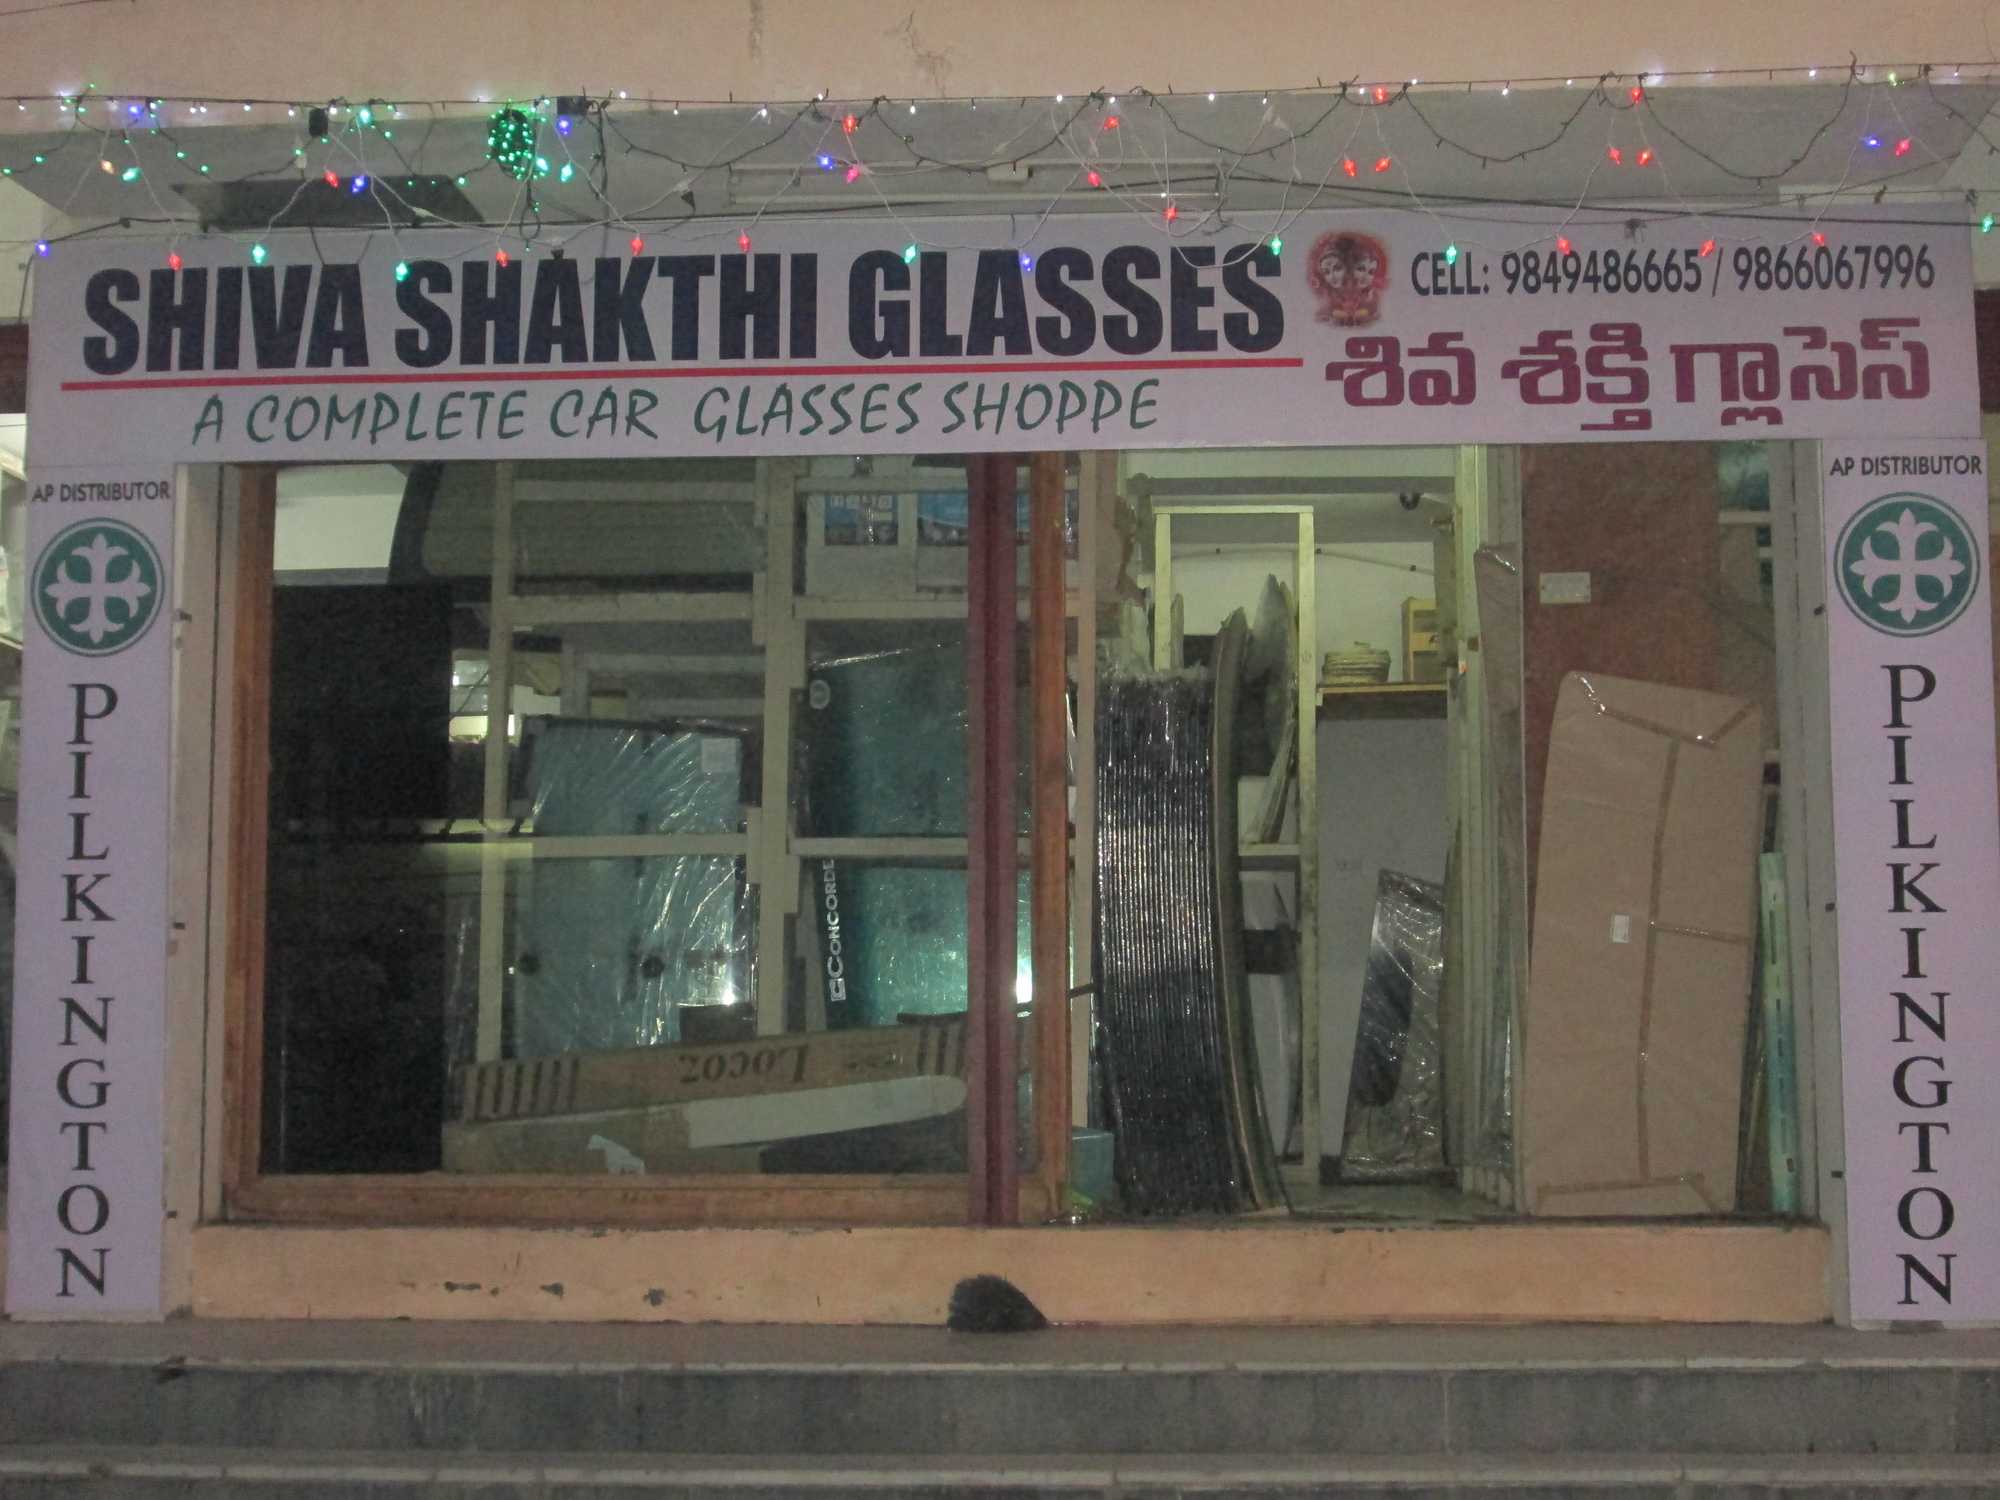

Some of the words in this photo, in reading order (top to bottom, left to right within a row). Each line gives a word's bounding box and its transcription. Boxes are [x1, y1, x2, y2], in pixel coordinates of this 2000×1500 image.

[83, 263, 369, 376] SHIVA
[394, 252, 818, 369] SHAKTHI
[848, 242, 1285, 359] GLASSES
[1411, 250, 1490, 296] CELL:
[1501, 246, 1702, 295] 9849486665
[1732, 243, 1936, 291] 9866067996
[191, 393, 224, 445] A
[245, 389, 528, 445] COMPLETE
[549, 385, 659, 440] CAR
[693, 381, 923, 442] GLASSES
[941, 377, 1161, 435] SHOPPE
[1325, 331, 1477, 408] శివ
[1500, 322, 1653, 432] శక్తి
[1669, 316, 1931, 426] గ్లాసెస్
[32, 482, 55, 502] AP
[60, 480, 171, 501] DISTRIBUTOR
[1829, 457, 1855, 477] AP
[1861, 455, 1982, 476] DISTRIBUTOR
[55, 682, 119, 1298] PILKINGTON
[1880, 664, 1958, 1306] PILKINGTON
